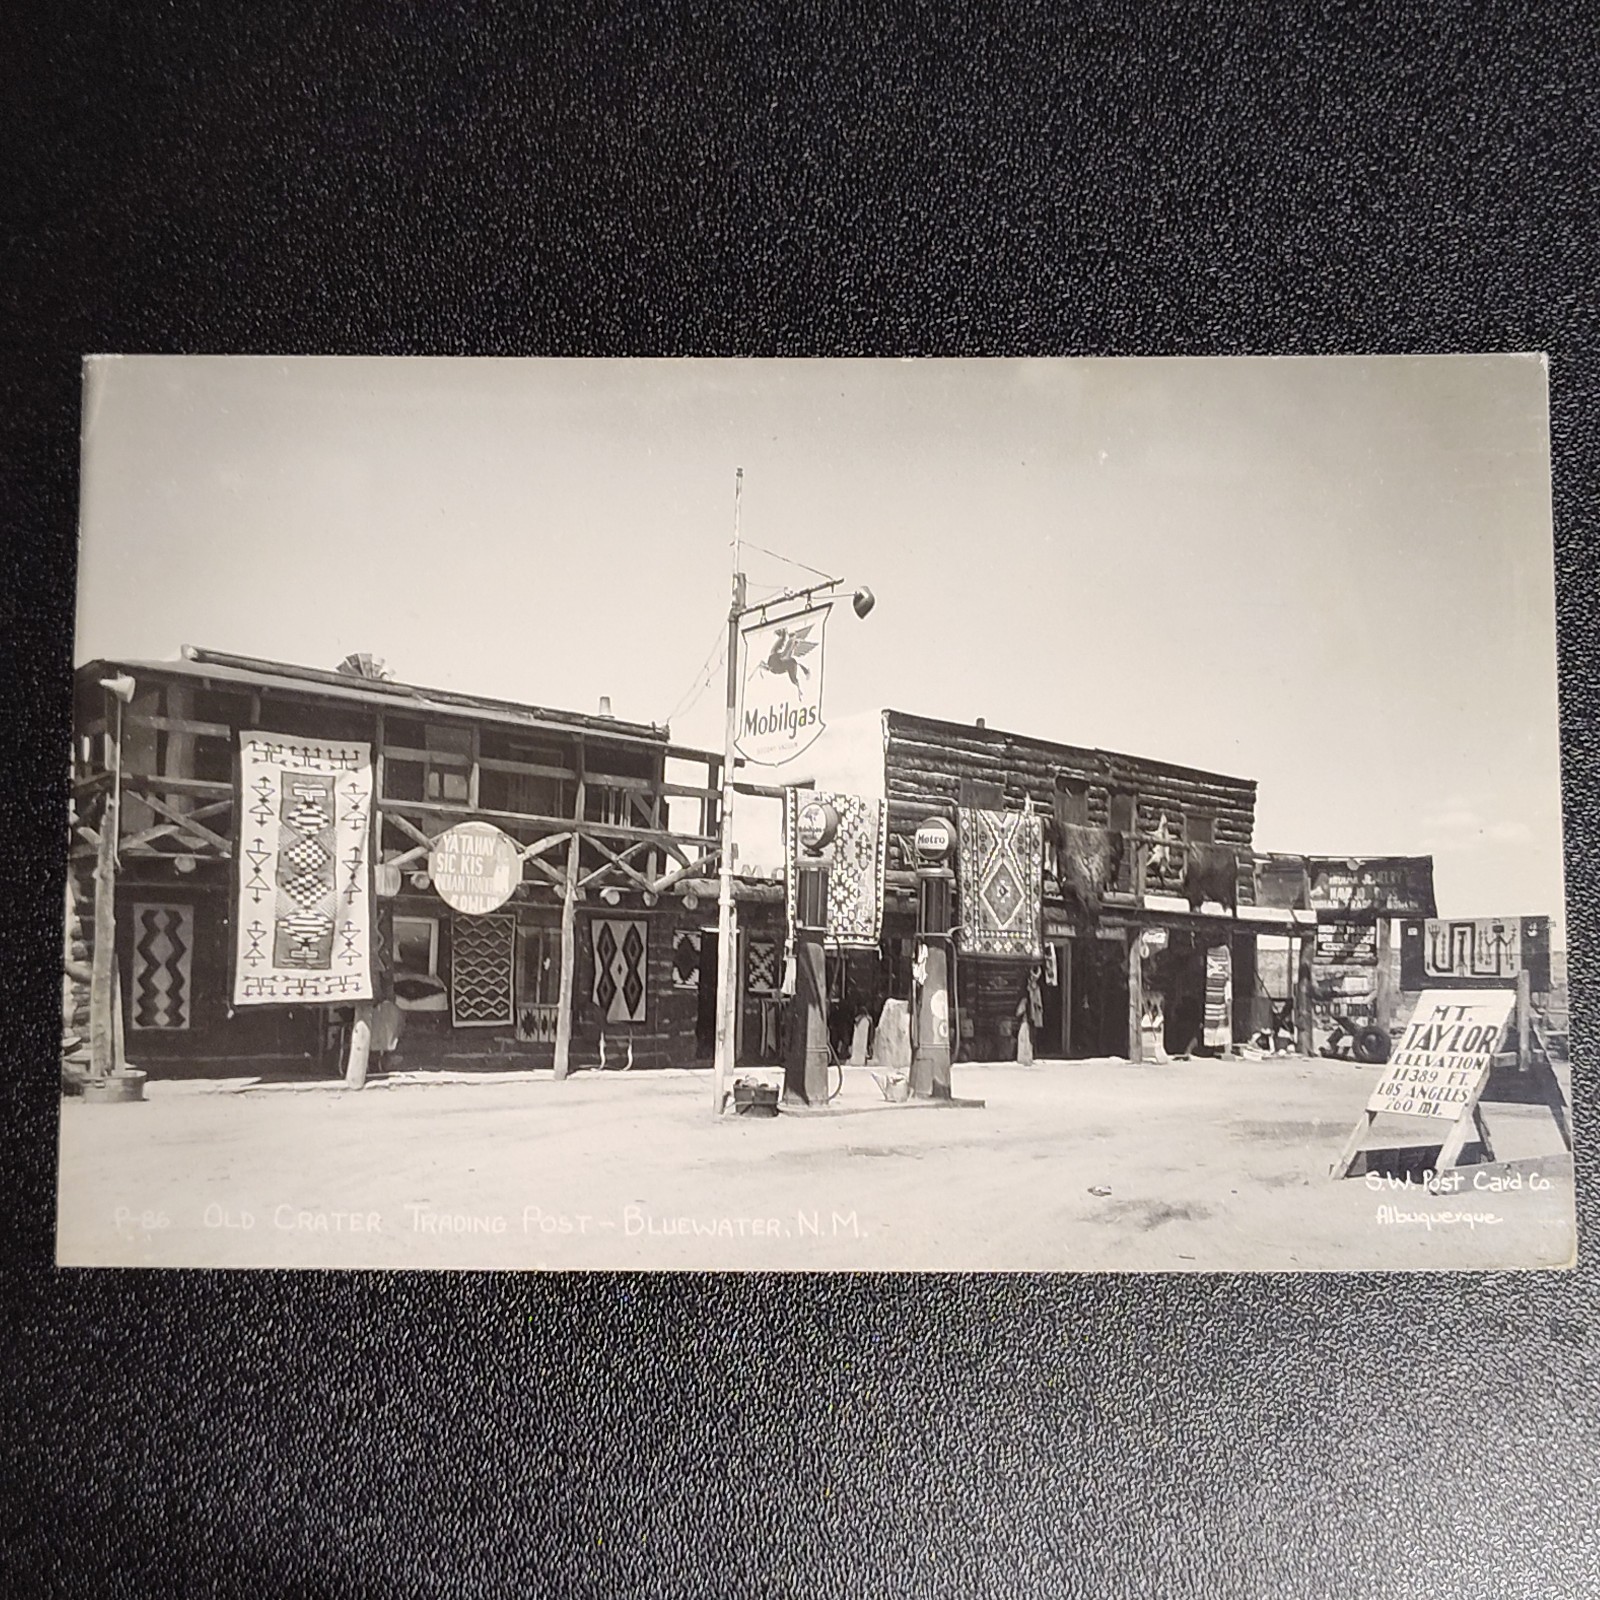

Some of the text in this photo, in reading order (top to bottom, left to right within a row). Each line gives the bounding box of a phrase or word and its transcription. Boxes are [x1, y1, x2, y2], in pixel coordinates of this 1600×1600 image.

[744, 702, 817, 739] Mobilgas
[443, 834, 459, 853] YA
[917, 833, 946, 845] Metro
[437, 853, 483, 876] SIC KIS
[1431, 1005, 1472, 1021] MT.
[1405, 1023, 1498, 1053] TAYLOR
[1393, 1053, 1485, 1070] ELEVATION
[1392, 1068, 1468, 1086] 11389 FT.
[1377, 1081, 1468, 1103] LOS ANGELES
[1385, 1098, 1413, 1112] 760
[1422, 1170, 1465, 1192] Post
[1473, 1171, 1522, 1192] Card
[114, 1206, 171, 1229] P-86
[203, 1203, 255, 1229] OLD
[274, 1203, 382, 1232] CRATER
[404, 1204, 507, 1234] TRADING
[522, 1205, 592, 1234] POST
[623, 1205, 791, 1238] BLUEWATER,
[1376, 1204, 1503, 1231] Albuquerque
